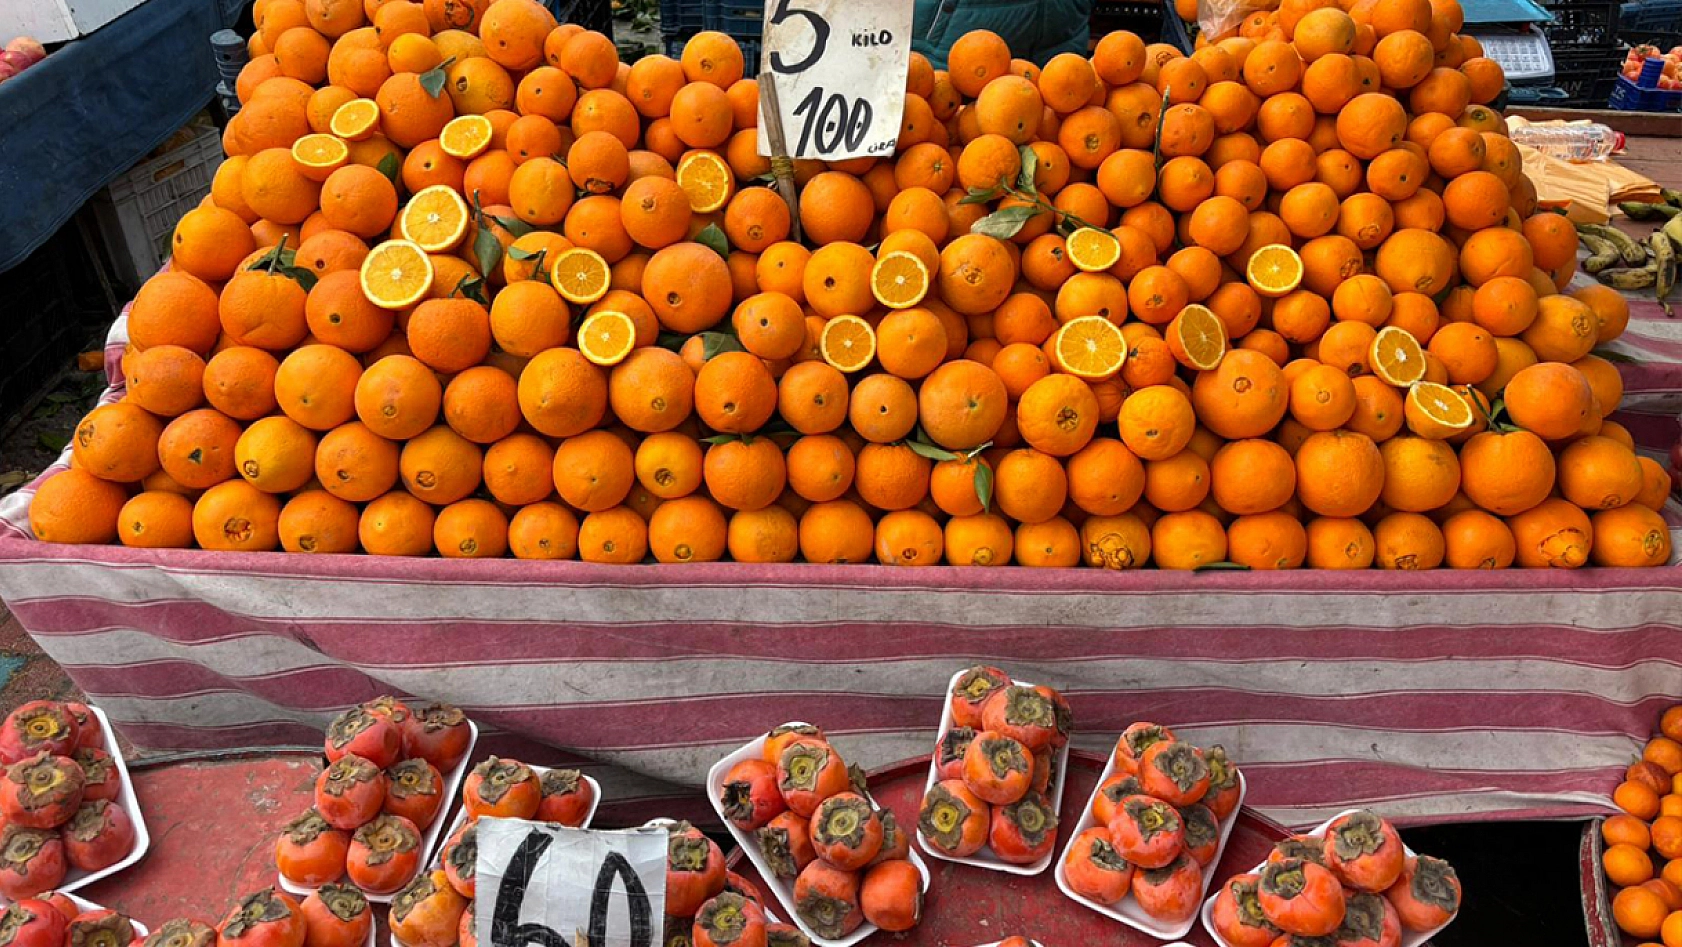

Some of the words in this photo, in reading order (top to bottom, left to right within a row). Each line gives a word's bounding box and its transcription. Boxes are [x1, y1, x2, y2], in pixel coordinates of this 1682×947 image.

[770, 0, 831, 74] 5
[793, 87, 873, 157] 100
[491, 826, 653, 947] 60
